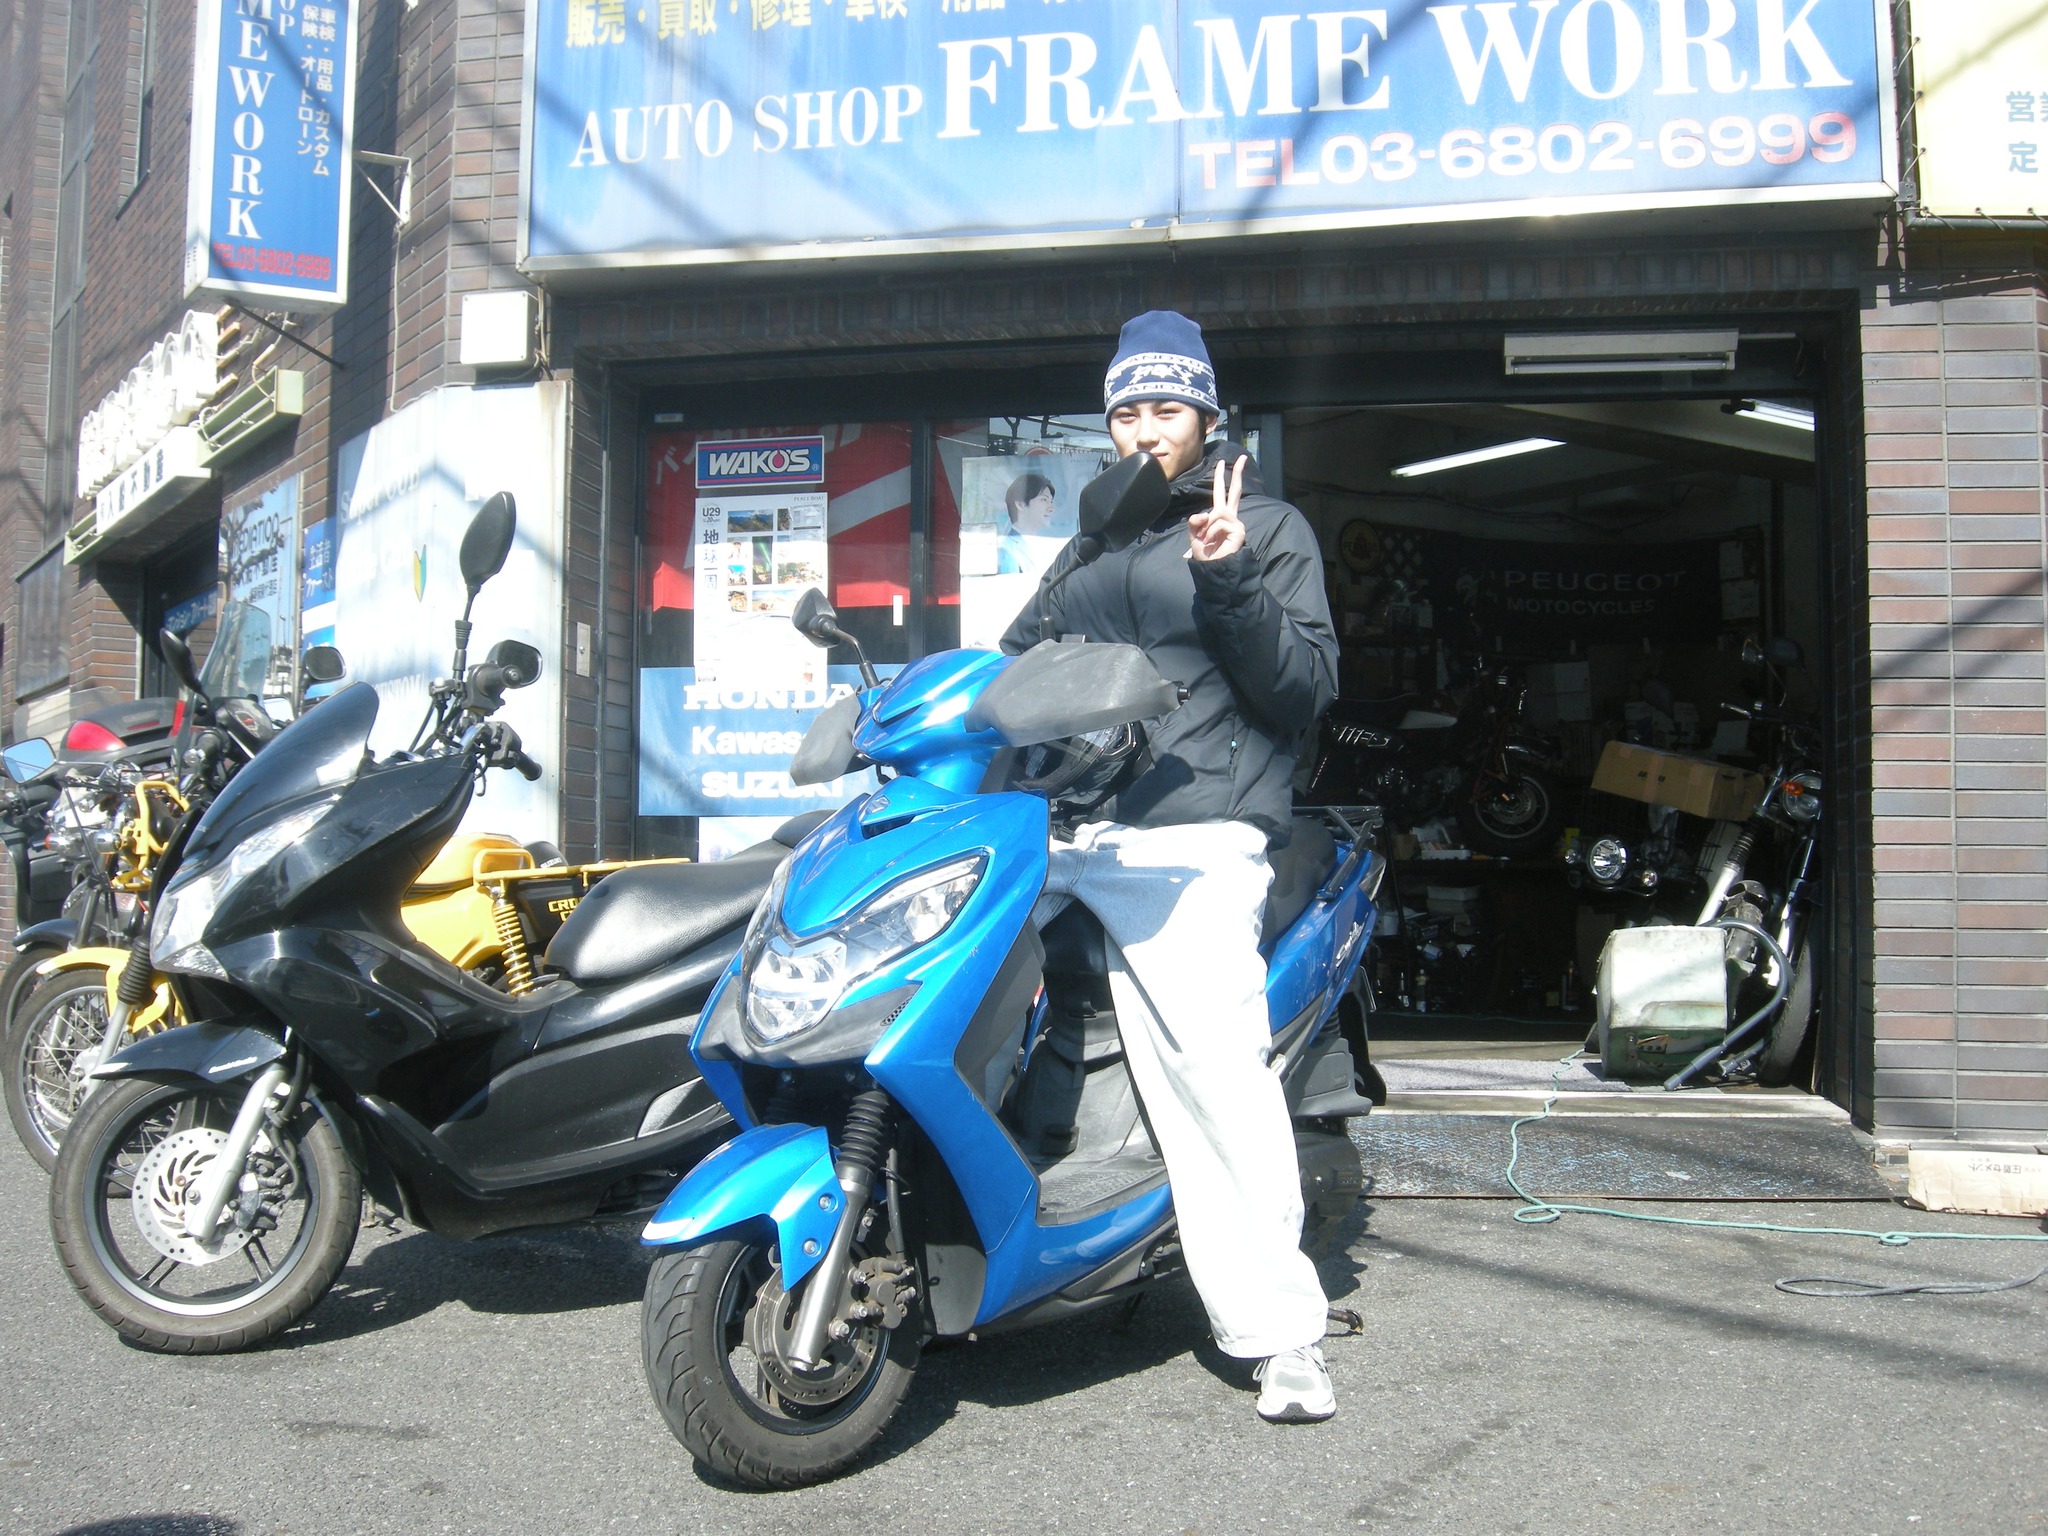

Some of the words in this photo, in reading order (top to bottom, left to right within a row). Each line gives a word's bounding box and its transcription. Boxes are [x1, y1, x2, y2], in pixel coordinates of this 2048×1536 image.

[568, 98, 733, 168] AUTO
[752, 84, 924, 153] SHOP
[936, 9, 1391, 139] FRAME
[1426, 0, 1854, 106] WORK
[1187, 111, 1858, 190] TEL03-6802-6999
[213, 242, 331, 281] TEL03-6802-6999
[708, 448, 811, 477] WAKO'S
[702, 507, 721, 517] U29
[1504, 570, 1687, 592] PEUGEOT
[1506, 597, 1655, 615] MOTOCYCLES
[683, 683, 857, 711] HONDA
[691, 726, 803, 756] Kawas
[548, 896, 583, 912] CRO
